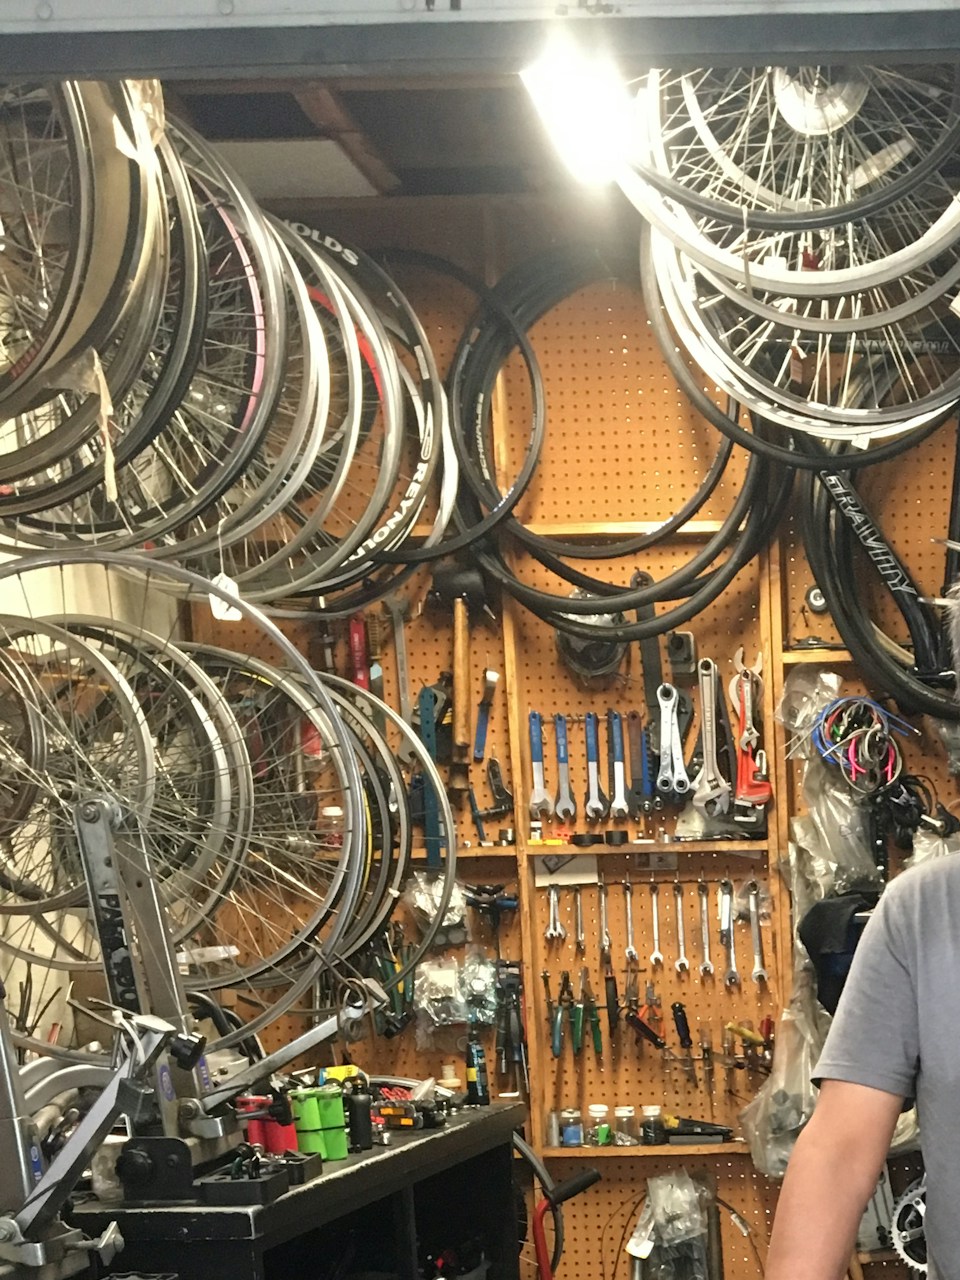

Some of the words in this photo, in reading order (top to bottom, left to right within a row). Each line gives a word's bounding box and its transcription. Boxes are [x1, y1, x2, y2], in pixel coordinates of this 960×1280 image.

[284, 219, 360, 266] OLDS
[340, 462, 429, 567] REYNOL
[820, 470, 918, 596] GRAVITY
